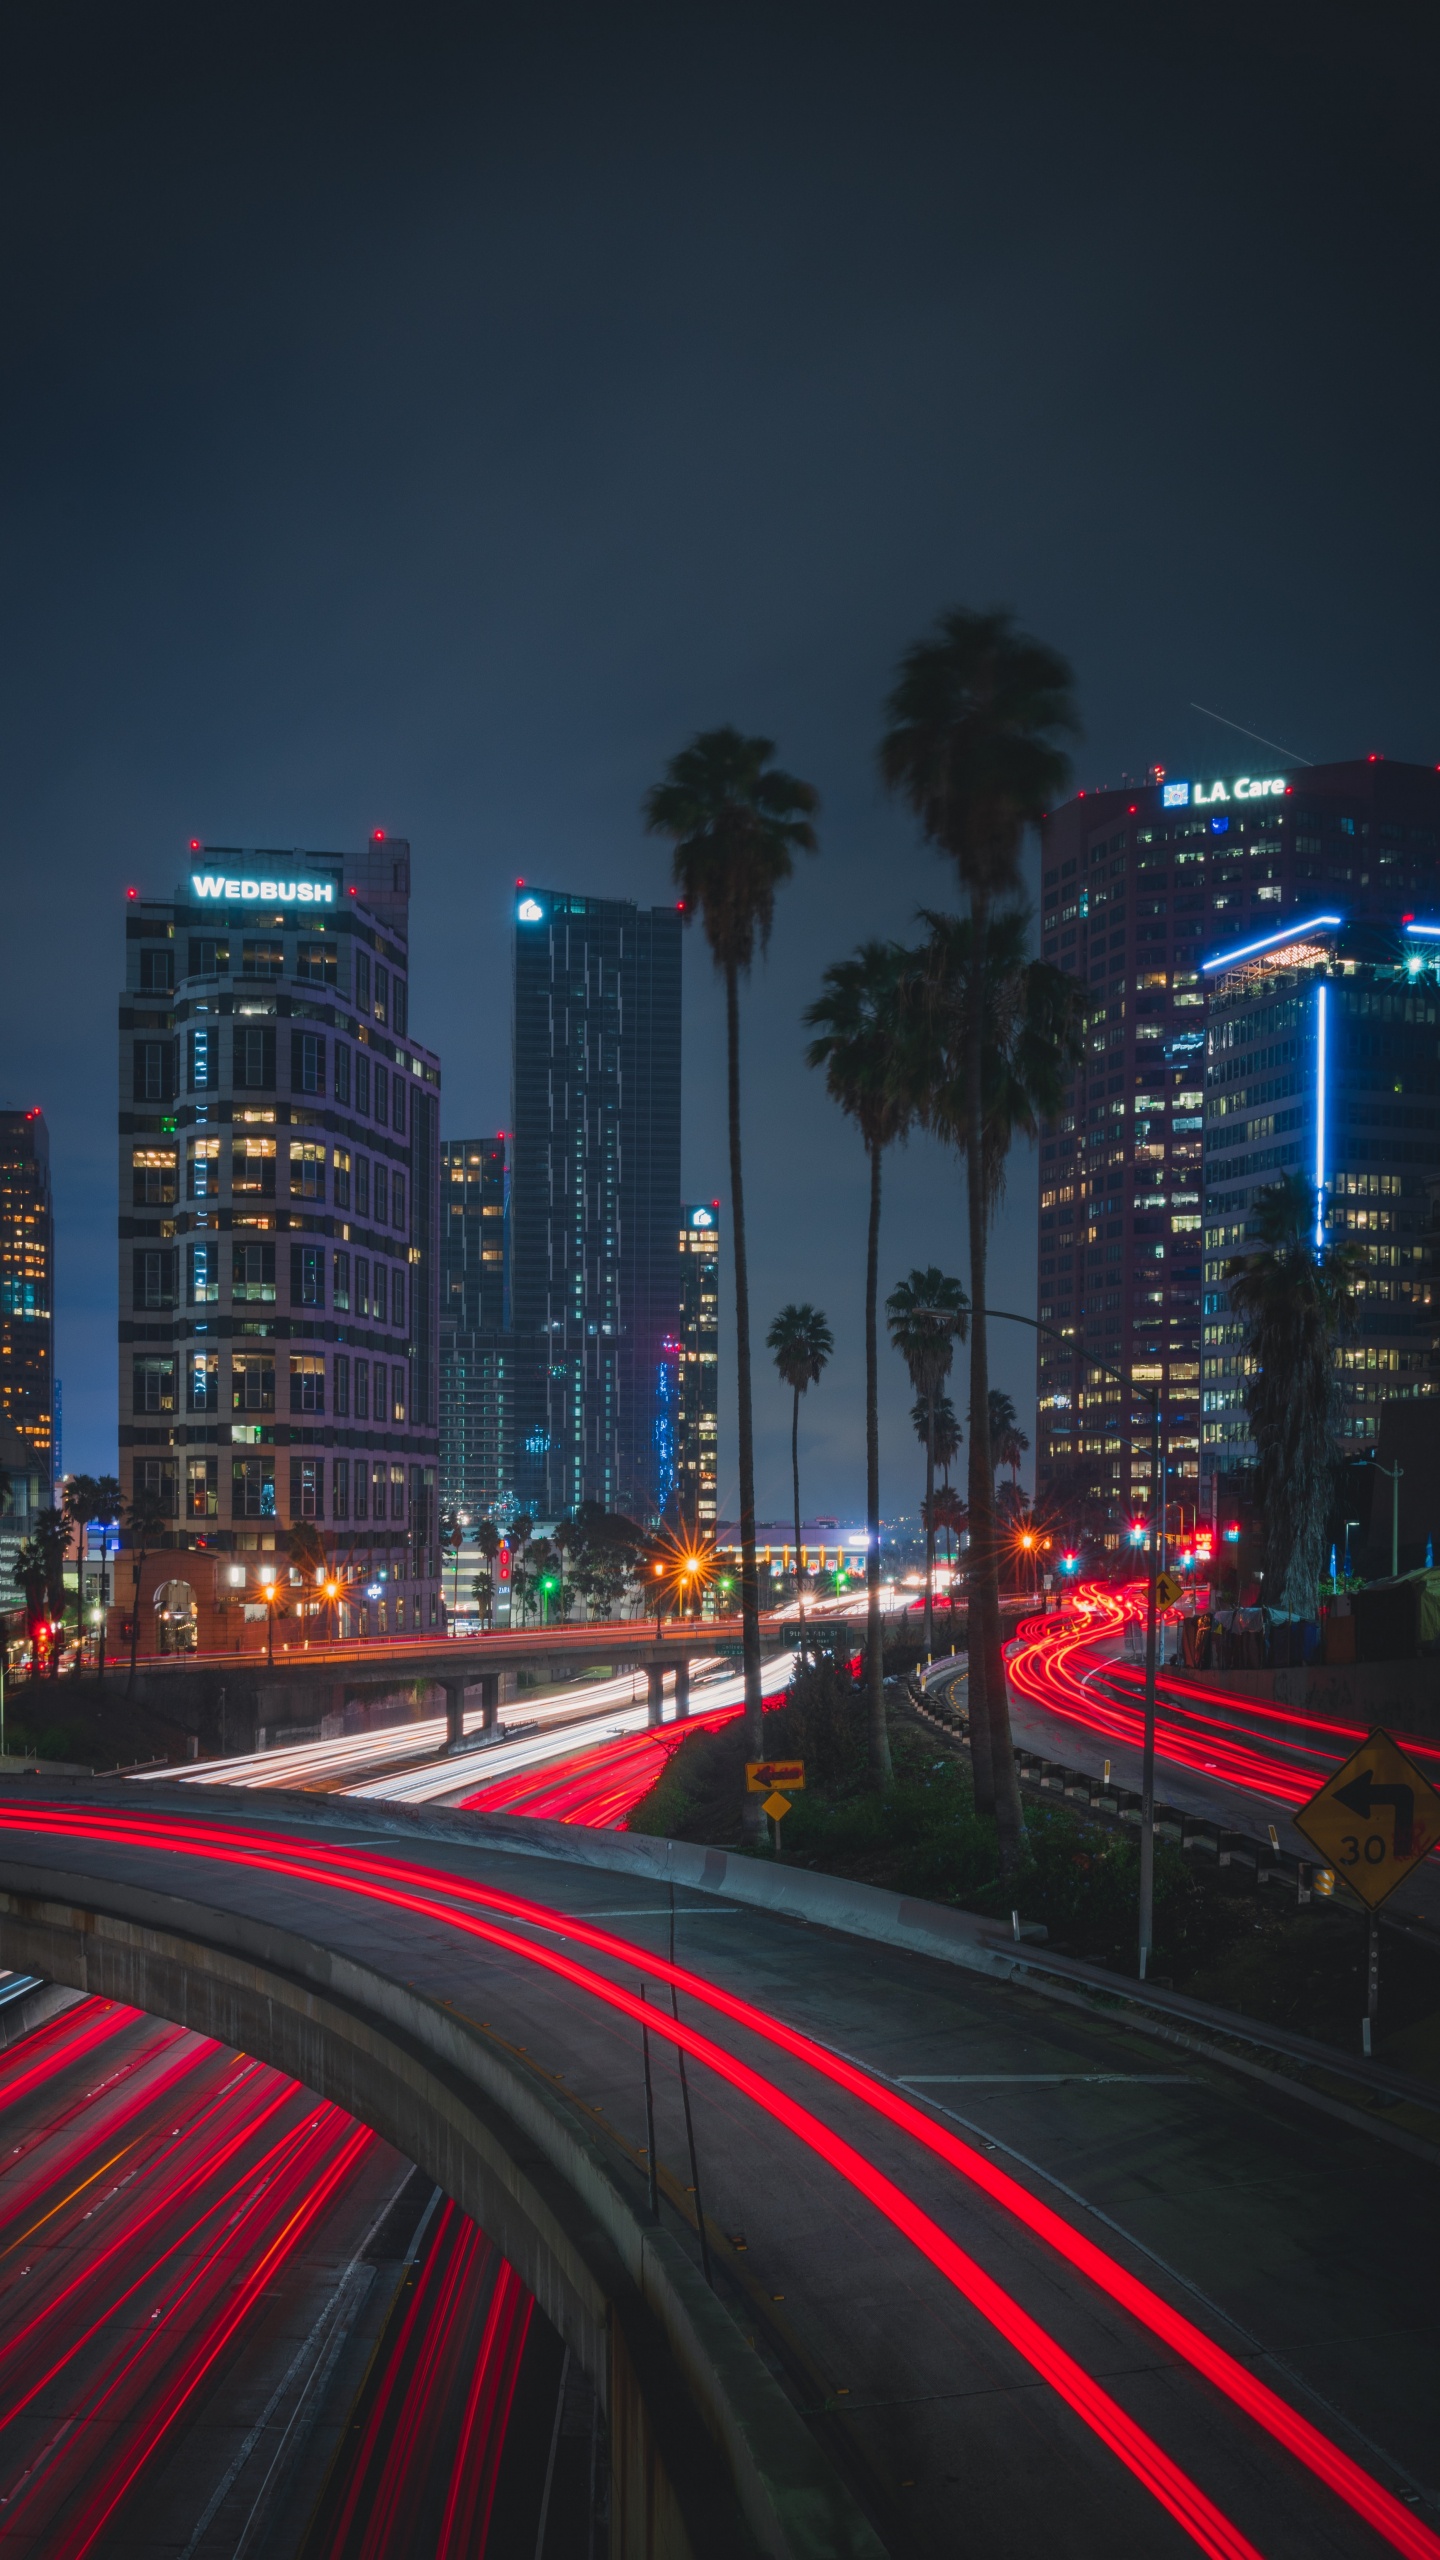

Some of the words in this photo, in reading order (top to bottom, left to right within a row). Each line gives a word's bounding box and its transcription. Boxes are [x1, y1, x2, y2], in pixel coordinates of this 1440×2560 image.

[1193, 781, 1230, 804] L.A.
[1234, 778, 1285, 799] Care
[192, 876, 332, 902] WEDBUSH
[1338, 1834, 1386, 1866] 30
